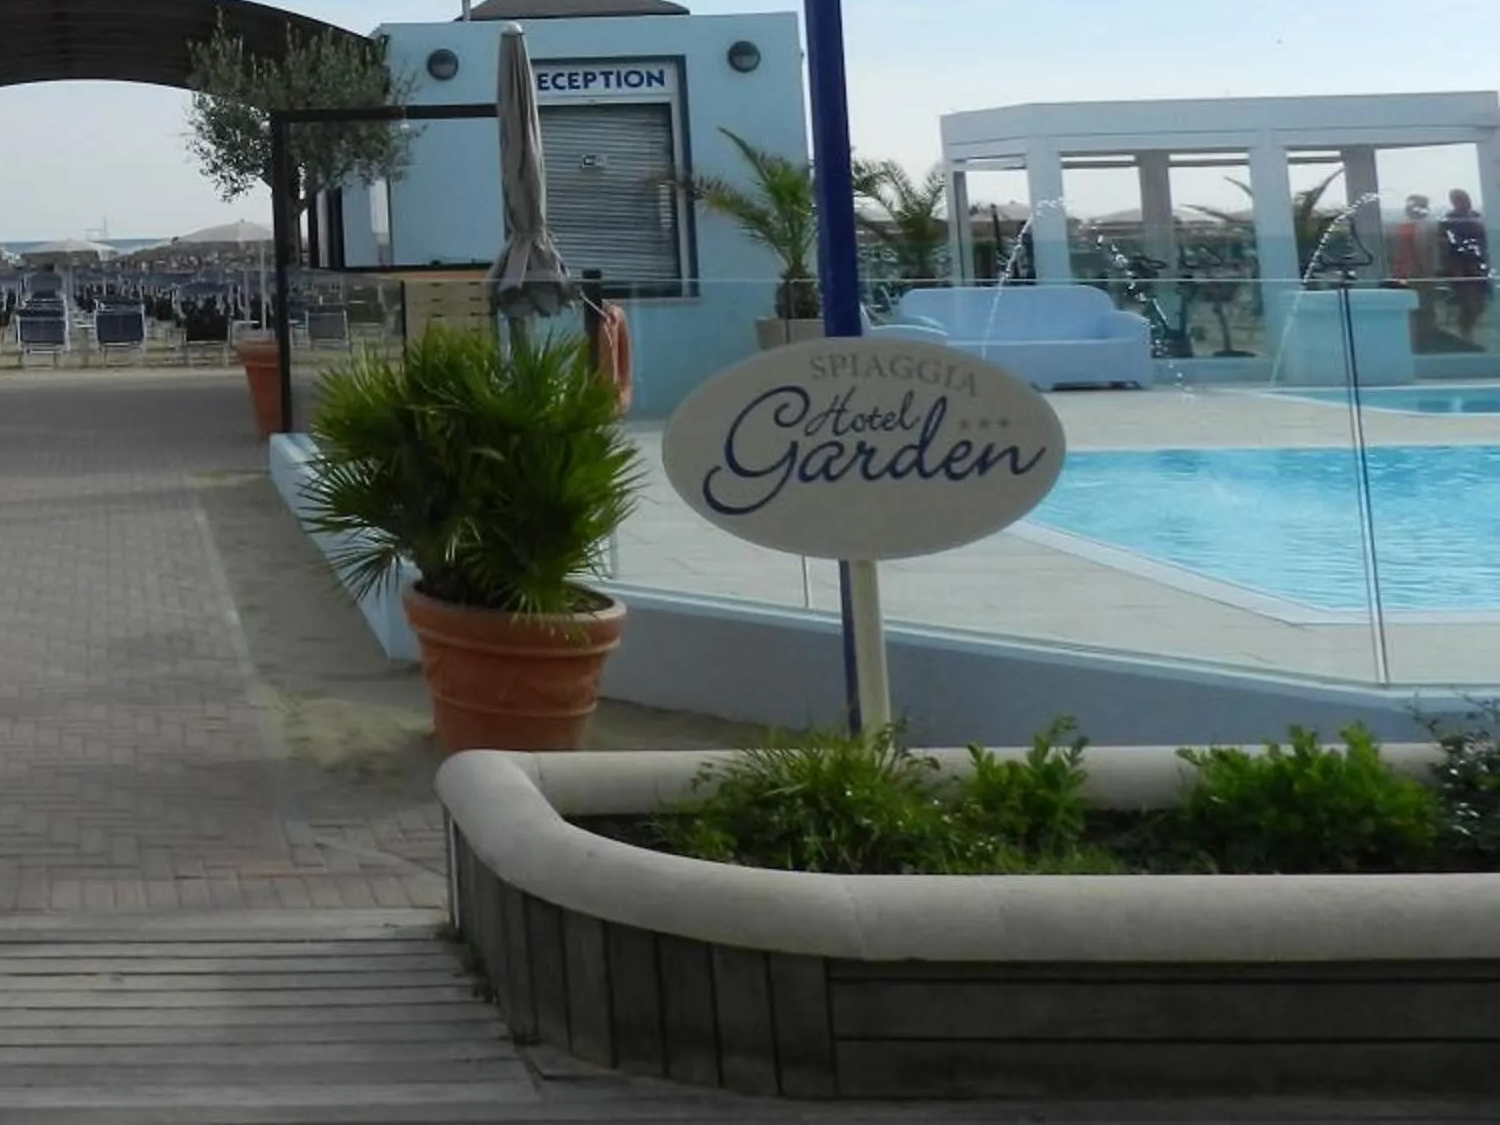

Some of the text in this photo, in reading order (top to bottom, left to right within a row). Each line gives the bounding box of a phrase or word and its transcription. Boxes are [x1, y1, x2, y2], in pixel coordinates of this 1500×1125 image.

[537, 69, 666, 91] ECEPTION
[810, 354, 978, 397] SPIAGGIA
[805, 386, 921, 437] Hotel
[702, 385, 1047, 515] Garden
